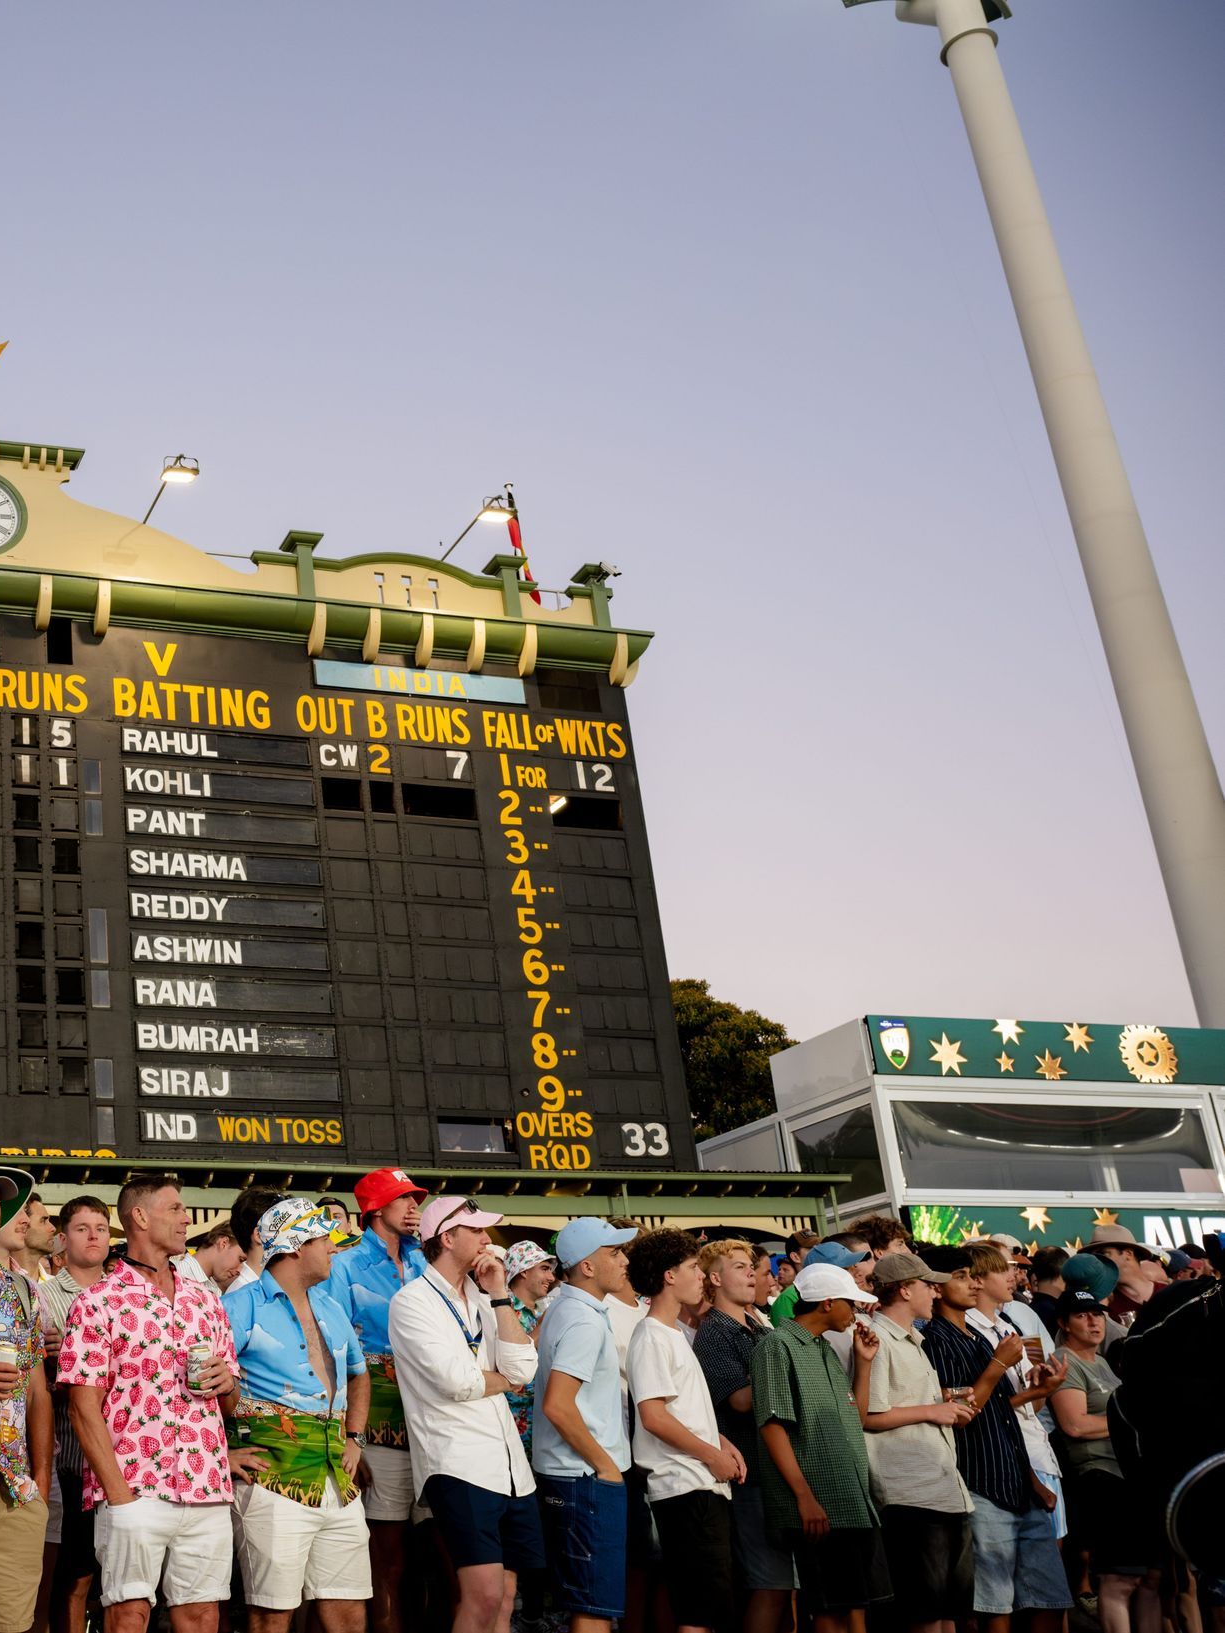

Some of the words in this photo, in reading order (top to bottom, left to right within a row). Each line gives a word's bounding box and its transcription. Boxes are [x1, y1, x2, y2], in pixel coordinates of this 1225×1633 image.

[141, 640, 179, 678] V
[374, 668, 465, 696] INDIA
[111, 676, 271, 729] BATTING
[296, 695, 357, 736] OUT
[367, 700, 386, 739] B
[393, 701, 471, 745] RUNS
[482, 711, 539, 751] FALL
[535, 725, 554, 743] OF
[554, 718, 626, 758] WKTS
[123, 728, 218, 757] RAHUL
[320, 744, 357, 767] CW
[368, 744, 391, 774] 2
[446, 751, 468, 779] 7
[125, 767, 211, 796] KOHLI
[500, 753, 511, 786] 1
[516, 765, 547, 788] FOR
[128, 808, 205, 836] PANT
[130, 850, 247, 881] SHARMA
[131, 893, 228, 921] REDDY
[134, 935, 242, 964] ASHWIN
[136, 978, 216, 1007] RANA
[138, 1024, 259, 1052] BUMRAH
[139, 1067, 231, 1097] SIRAJ
[146, 1113, 197, 1140] IND
[217, 1117, 271, 1142] WON
[275, 1119, 341, 1143] TOSS
[516, 1112, 593, 1137] OVERS
[622, 1123, 668, 1156] 33
